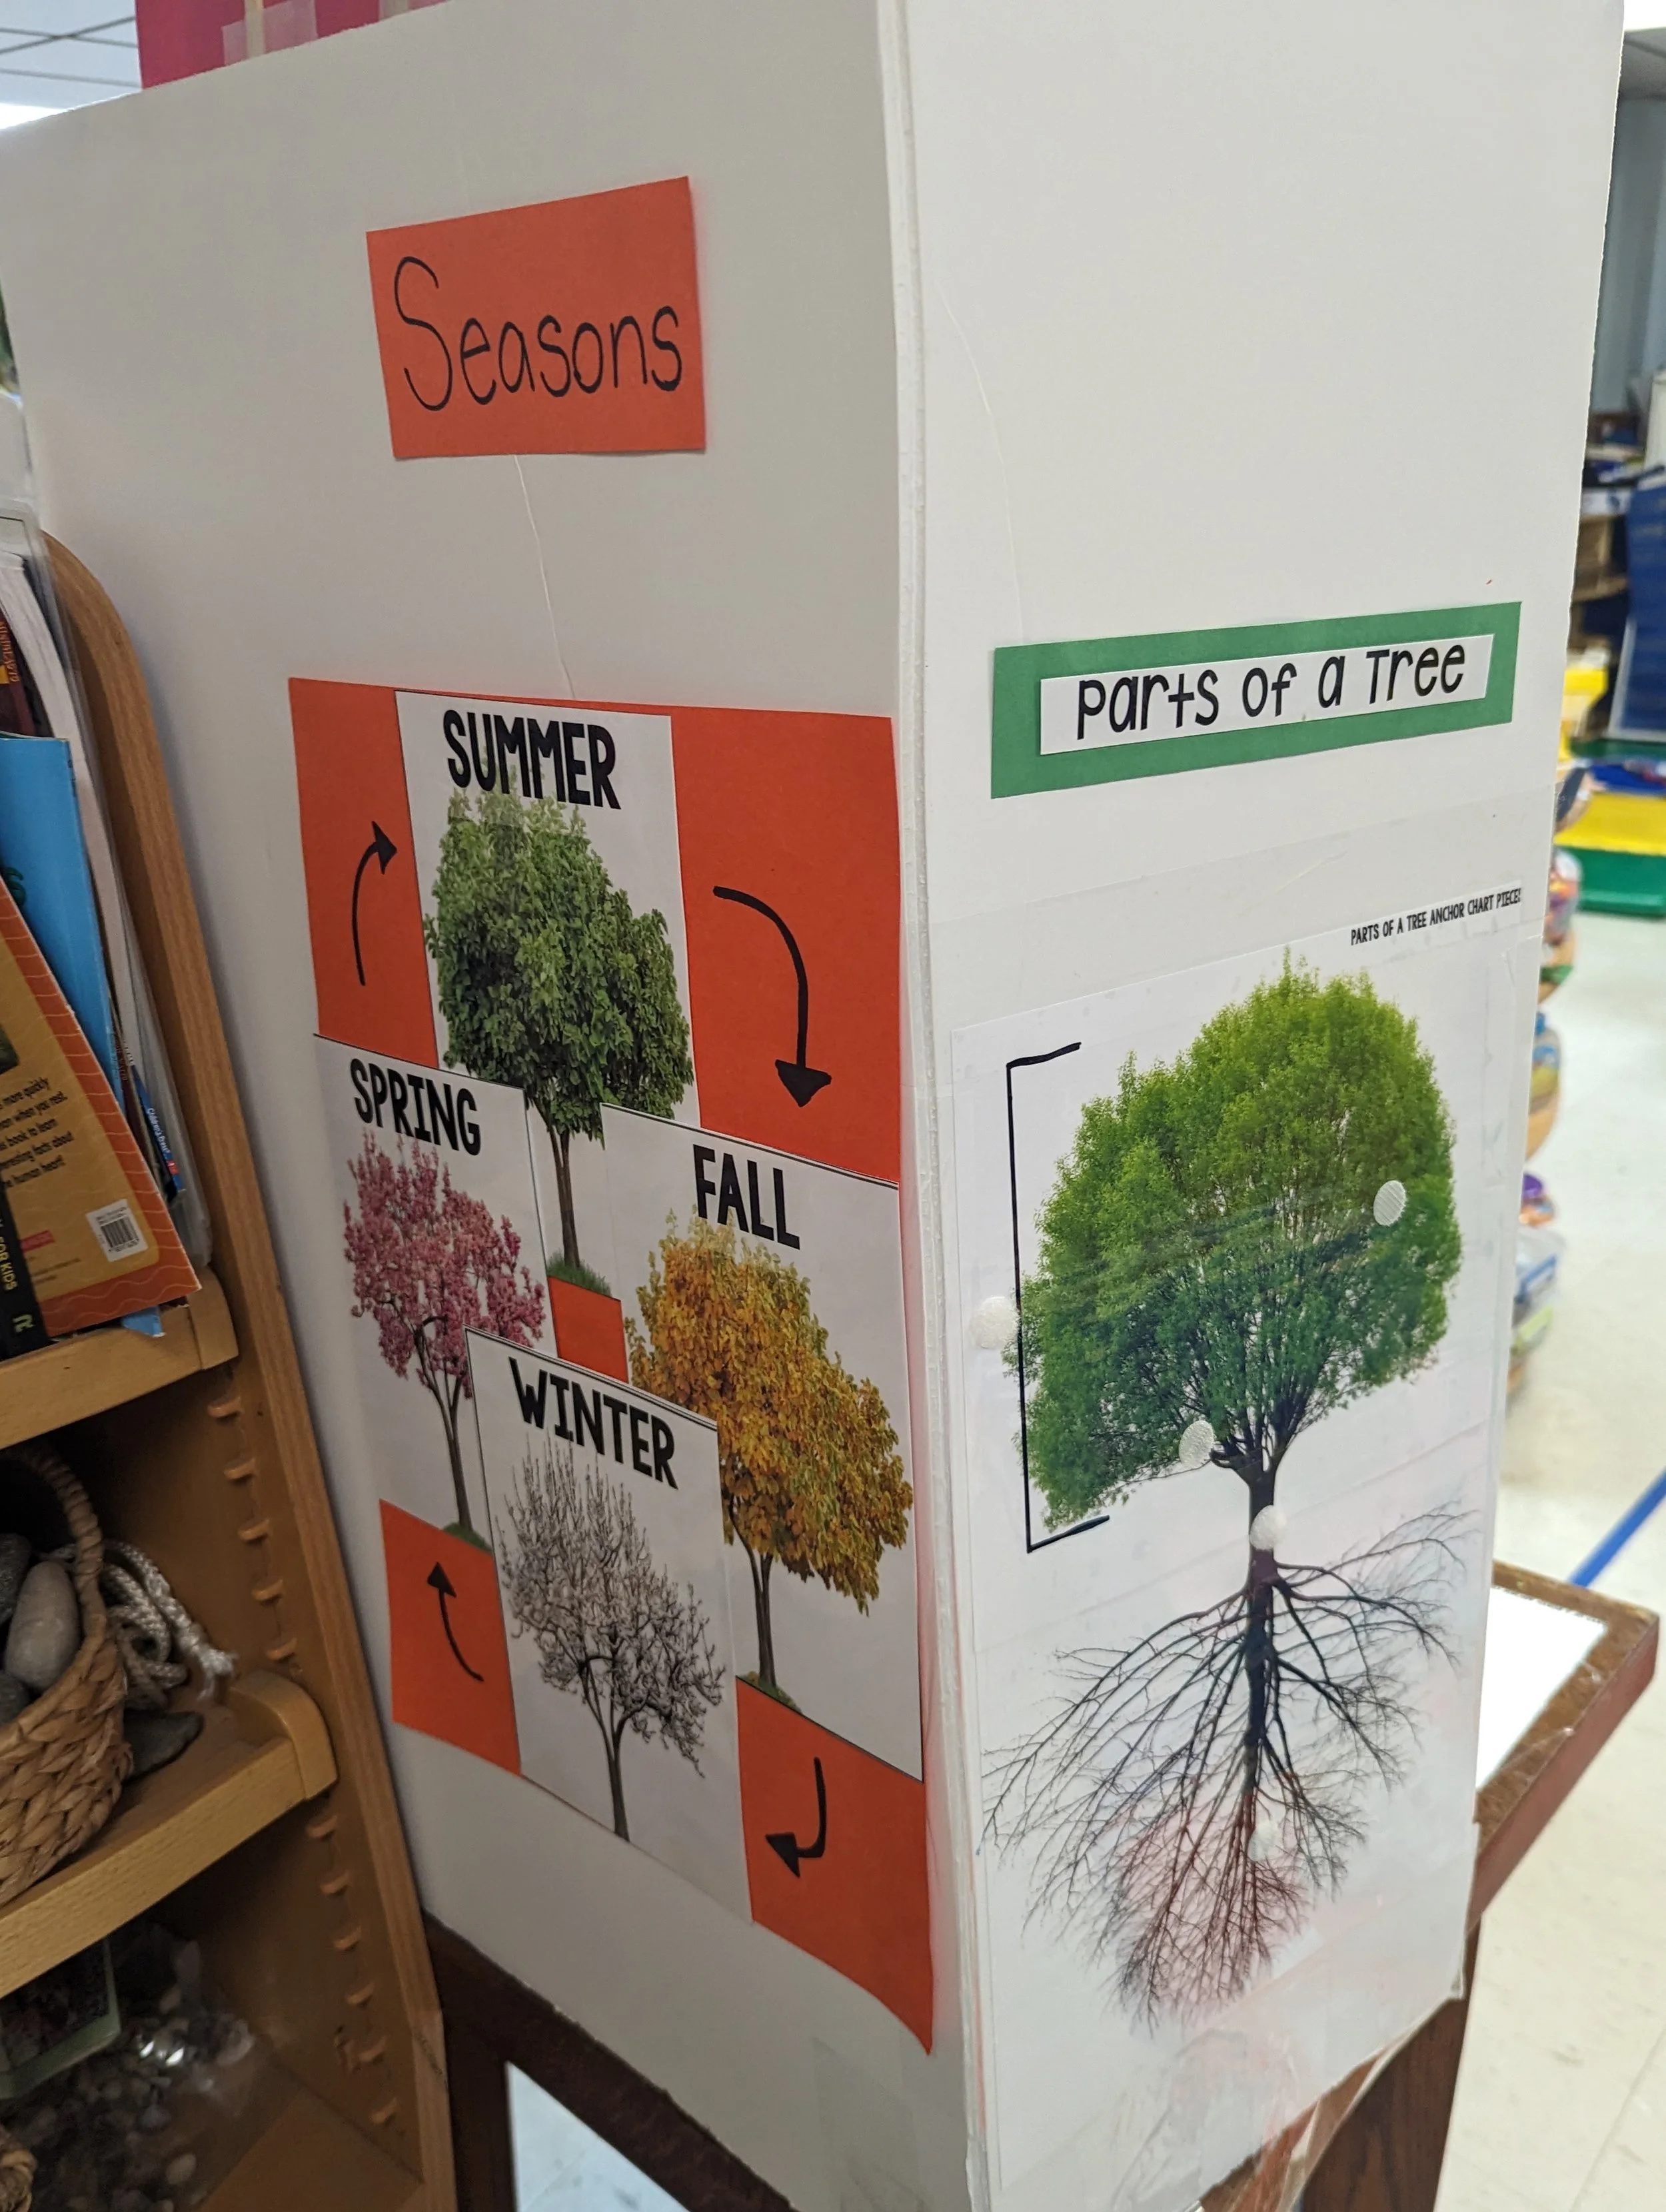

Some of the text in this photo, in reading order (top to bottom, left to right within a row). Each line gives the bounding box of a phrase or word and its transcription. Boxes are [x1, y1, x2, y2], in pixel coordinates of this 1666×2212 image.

[394, 256, 682, 412] Seasons
[1319, 655, 1346, 708] a
[1365, 644, 1466, 706] Tree
[443, 710, 622, 810] SUMMER
[1350, 923, 1379, 946] PARTS
[1382, 920, 1394, 937] OF
[1397, 917, 1403, 934] A
[1406, 911, 1427, 931] TREE
[1429, 902, 1465, 926] ANCHOR
[1467, 894, 1494, 915] CHART
[350, 1058, 481, 1156] SPRING
[693, 1144, 800, 1250] FALL
[0, 1262, 18, 1291] KIDS
[508, 1357, 678, 1490] WINTER
